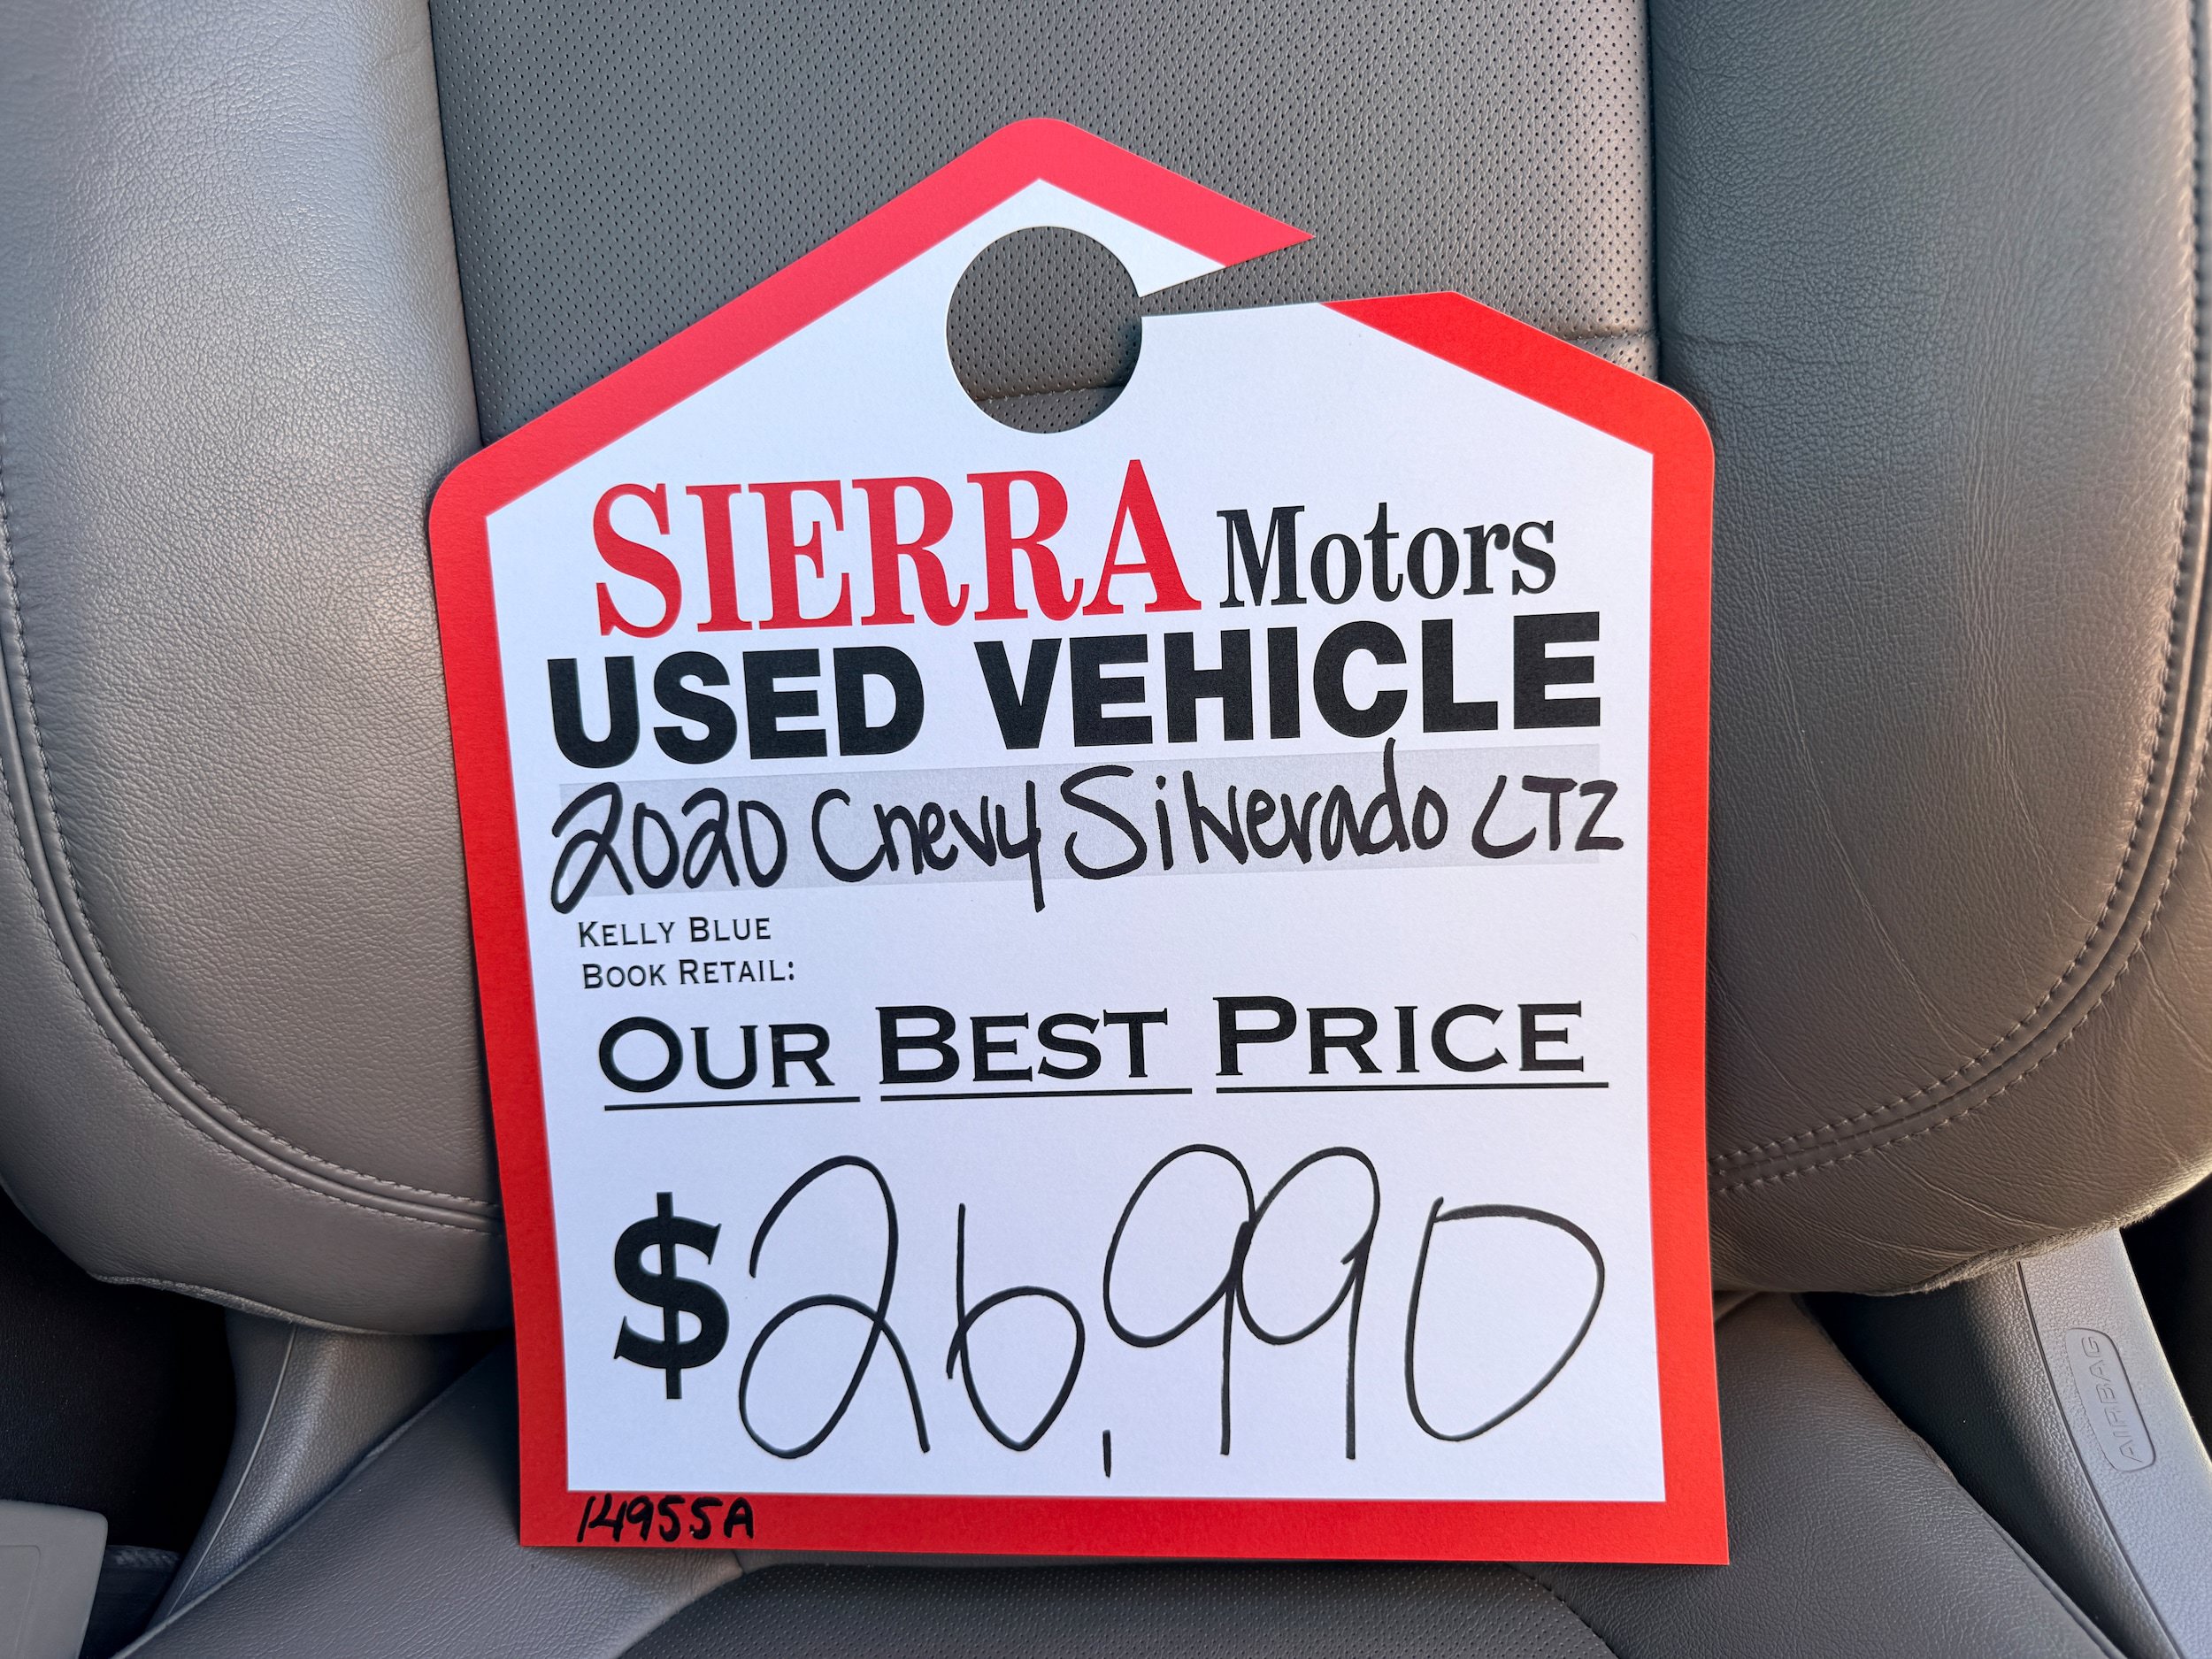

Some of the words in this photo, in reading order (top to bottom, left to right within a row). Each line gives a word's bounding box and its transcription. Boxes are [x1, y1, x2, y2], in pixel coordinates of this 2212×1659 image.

[592, 459, 1202, 639] SIERRA
[1216, 502, 1556, 609] Motors
[547, 645, 925, 769] USED
[973, 611, 1601, 750] VEHICLE
[550, 781, 787, 915] 2020
[1060, 737, 1448, 880] Silverado
[1471, 774, 1624, 859] LTZ
[578, 920, 676, 948] KELLY
[688, 916, 772, 942] BLUE
[582, 962, 667, 989] BOOK
[679, 957, 795, 985] RETAIL:
[598, 1016, 835, 1094] OUR
[875, 1005, 1168, 1085] BEST
[1212, 995, 1585, 1077] PRICE
[2081, 1336, 2142, 1463] AIRBAG
[576, 1493, 754, 1543] 14955A
